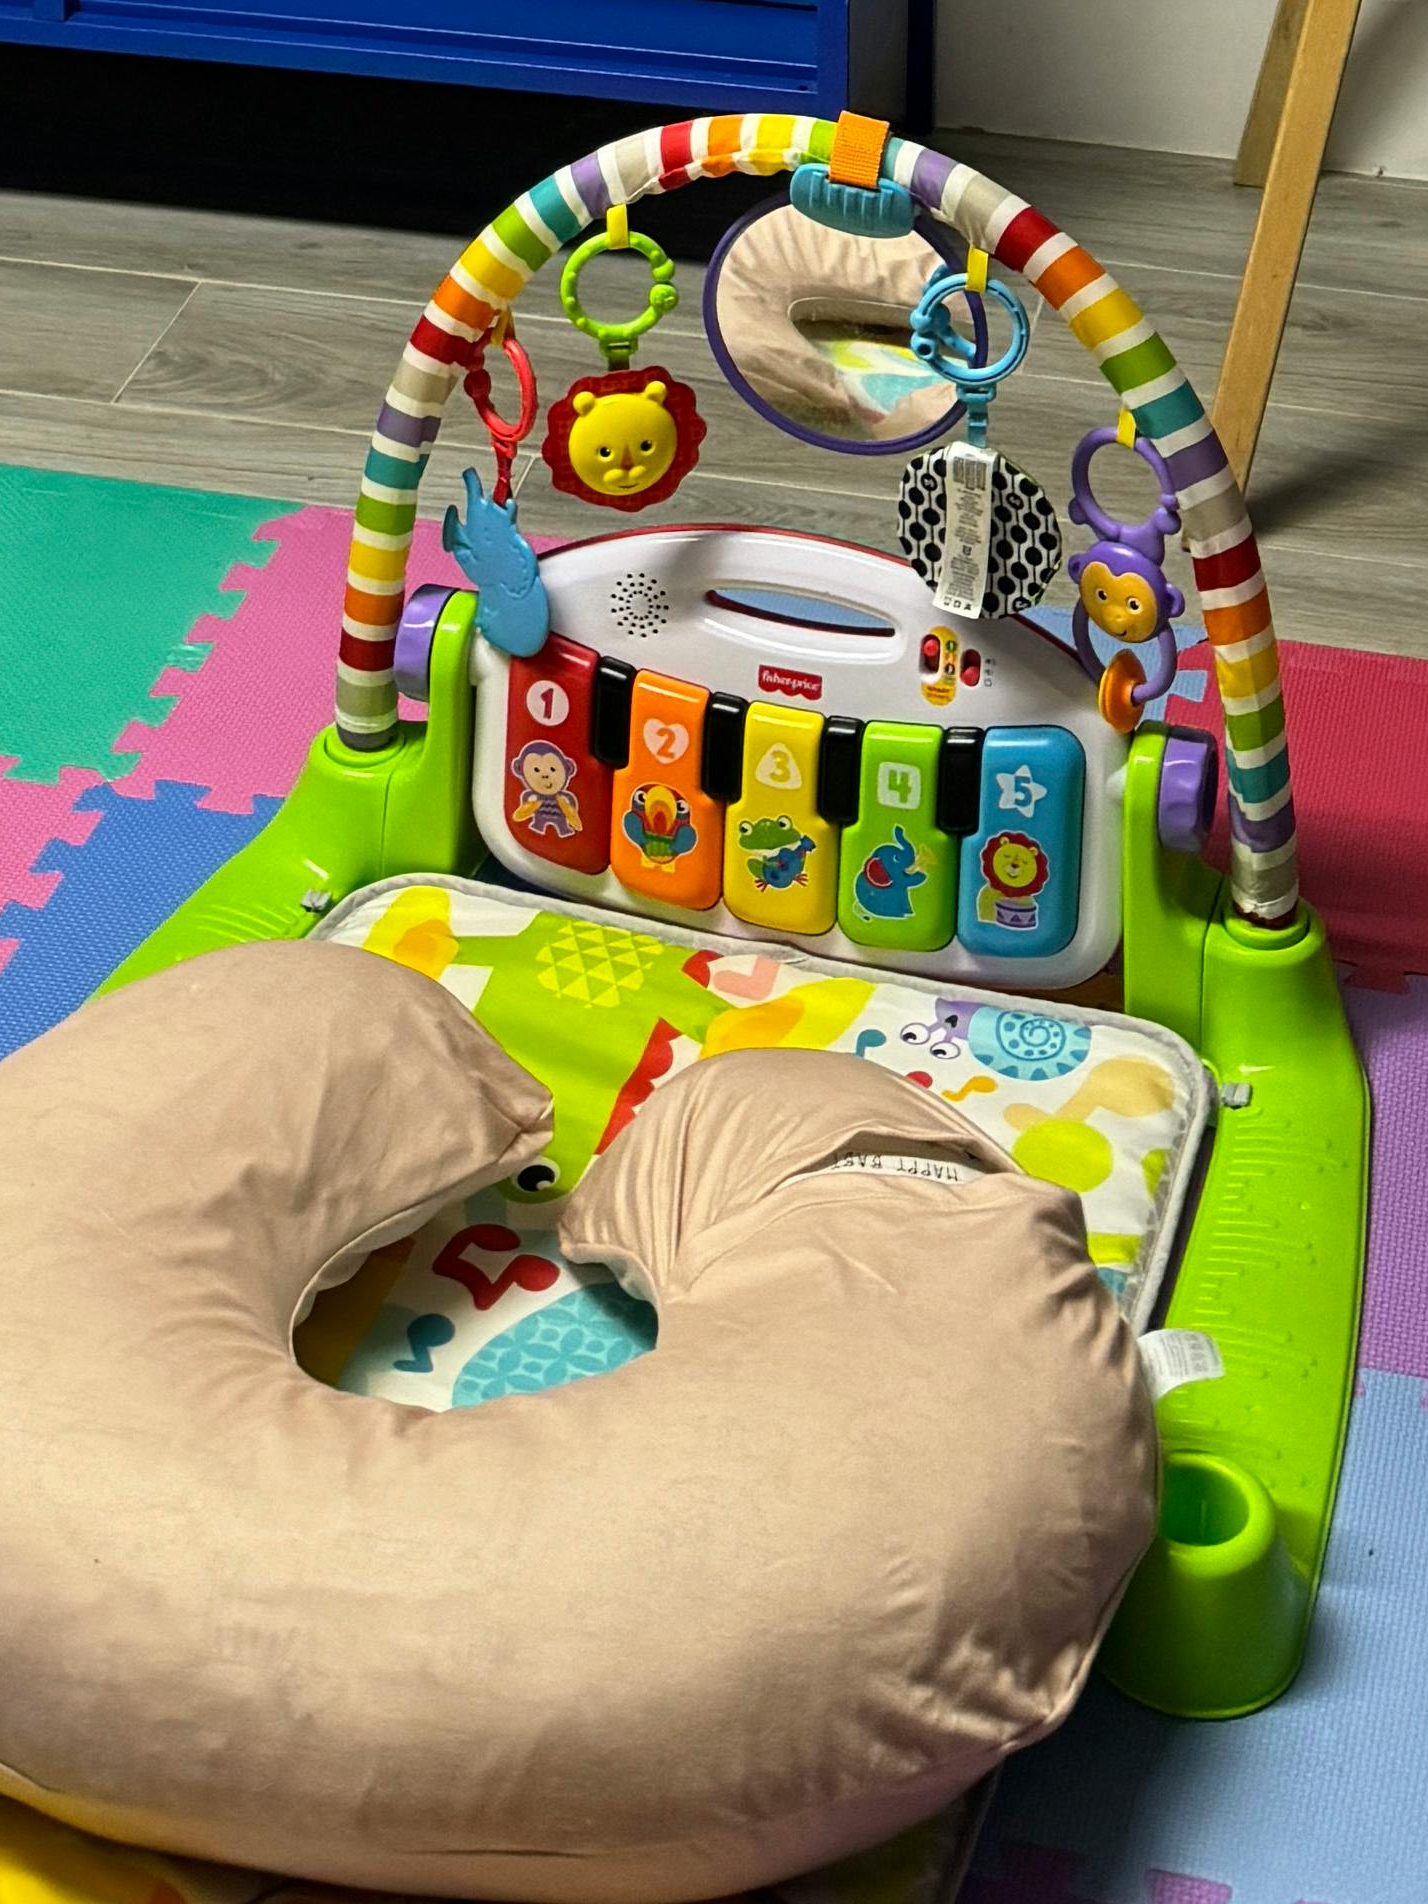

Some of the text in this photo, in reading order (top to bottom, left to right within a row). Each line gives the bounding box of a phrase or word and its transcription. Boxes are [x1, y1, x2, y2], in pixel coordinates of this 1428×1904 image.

[540, 688, 555, 720] 1
[655, 727, 677, 759] 2
[773, 750, 792, 784] 3
[888, 769, 913, 805] 4
[1014, 776, 1034, 808] 5
